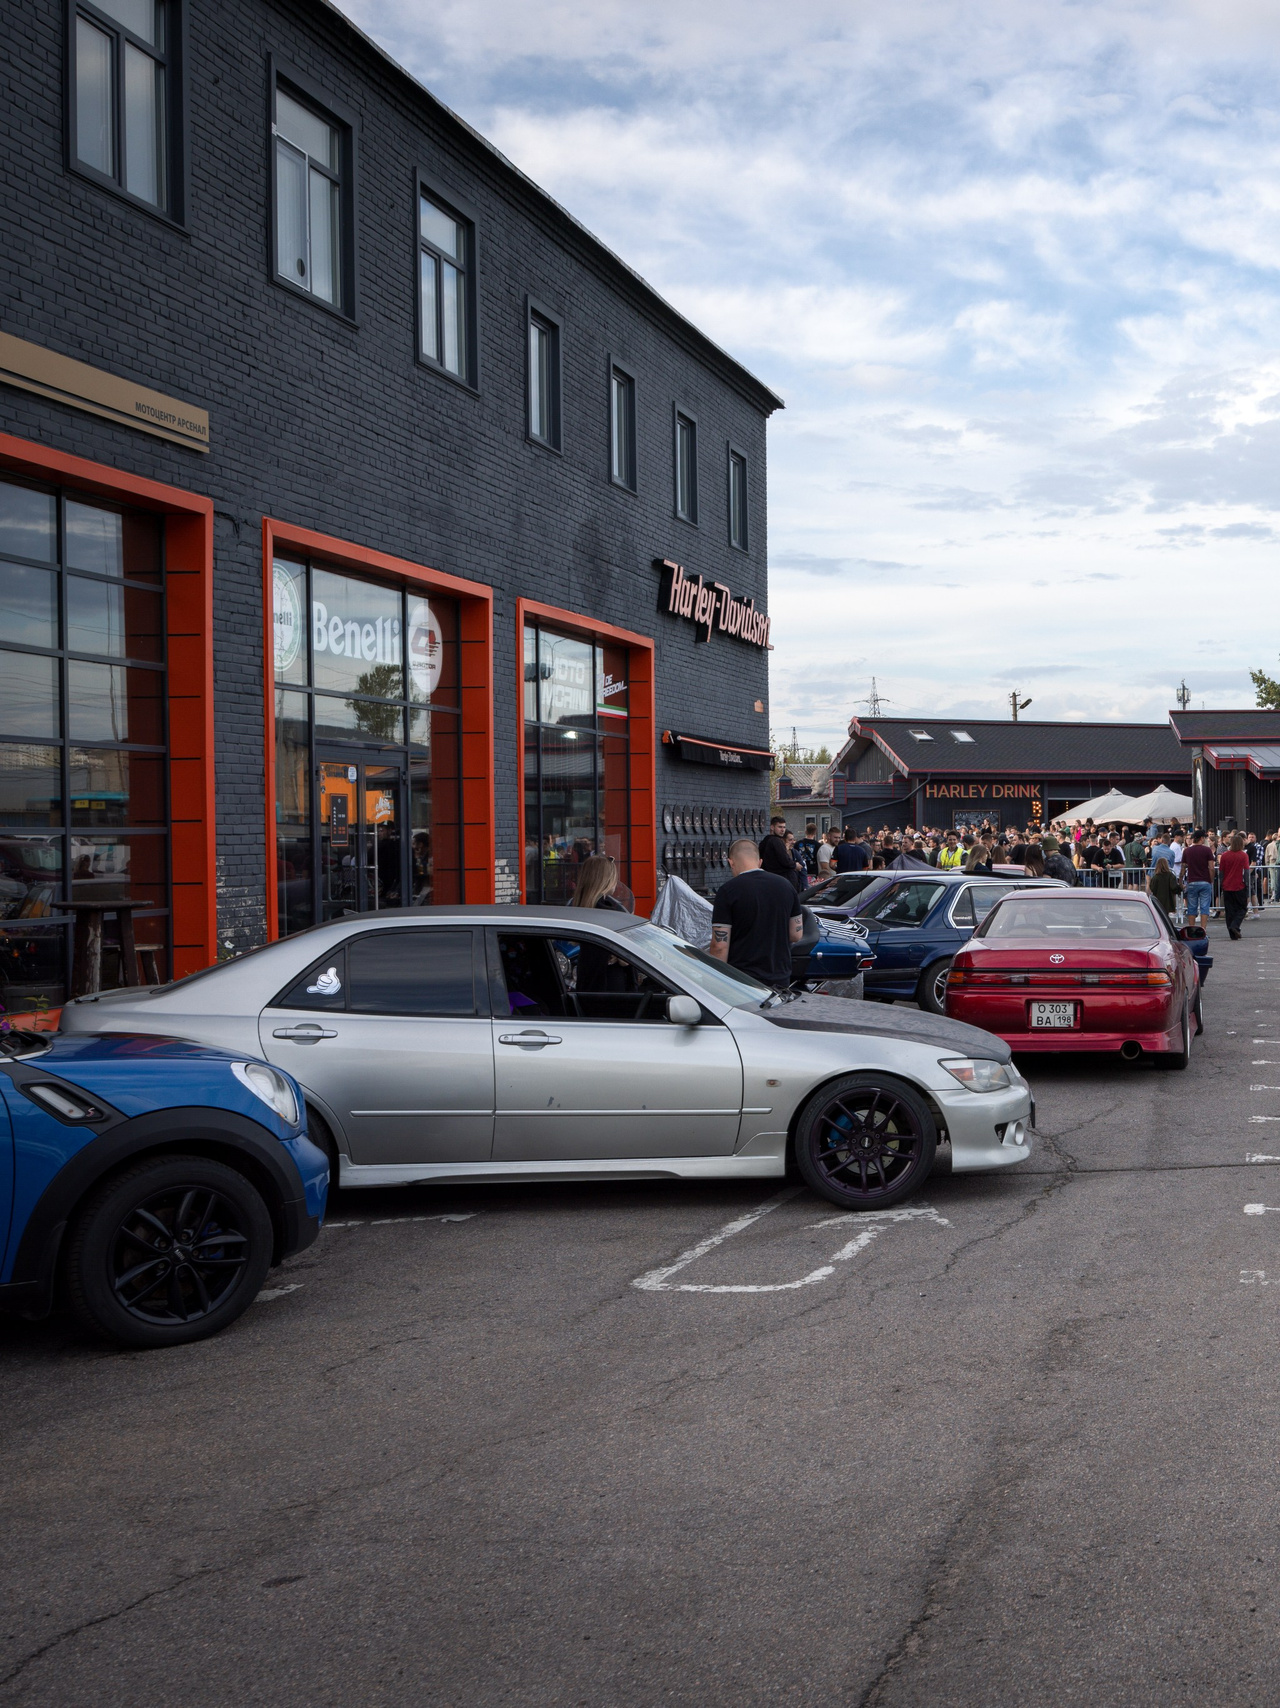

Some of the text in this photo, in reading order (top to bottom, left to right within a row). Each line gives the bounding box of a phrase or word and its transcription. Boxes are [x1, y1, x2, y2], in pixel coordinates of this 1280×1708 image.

[135, 402, 206, 436] МОТОЦЕНТР АРСЕНАЛ
[663, 559, 774, 650] Harley-Davidson
[273, 611, 293, 627] nelli
[313, 601, 400, 664] Benelli
[926, 784, 1041, 798] HARLEY DRINK
[1049, 1004, 1068, 1014] 303
[1057, 1016, 1071, 1024] 198
